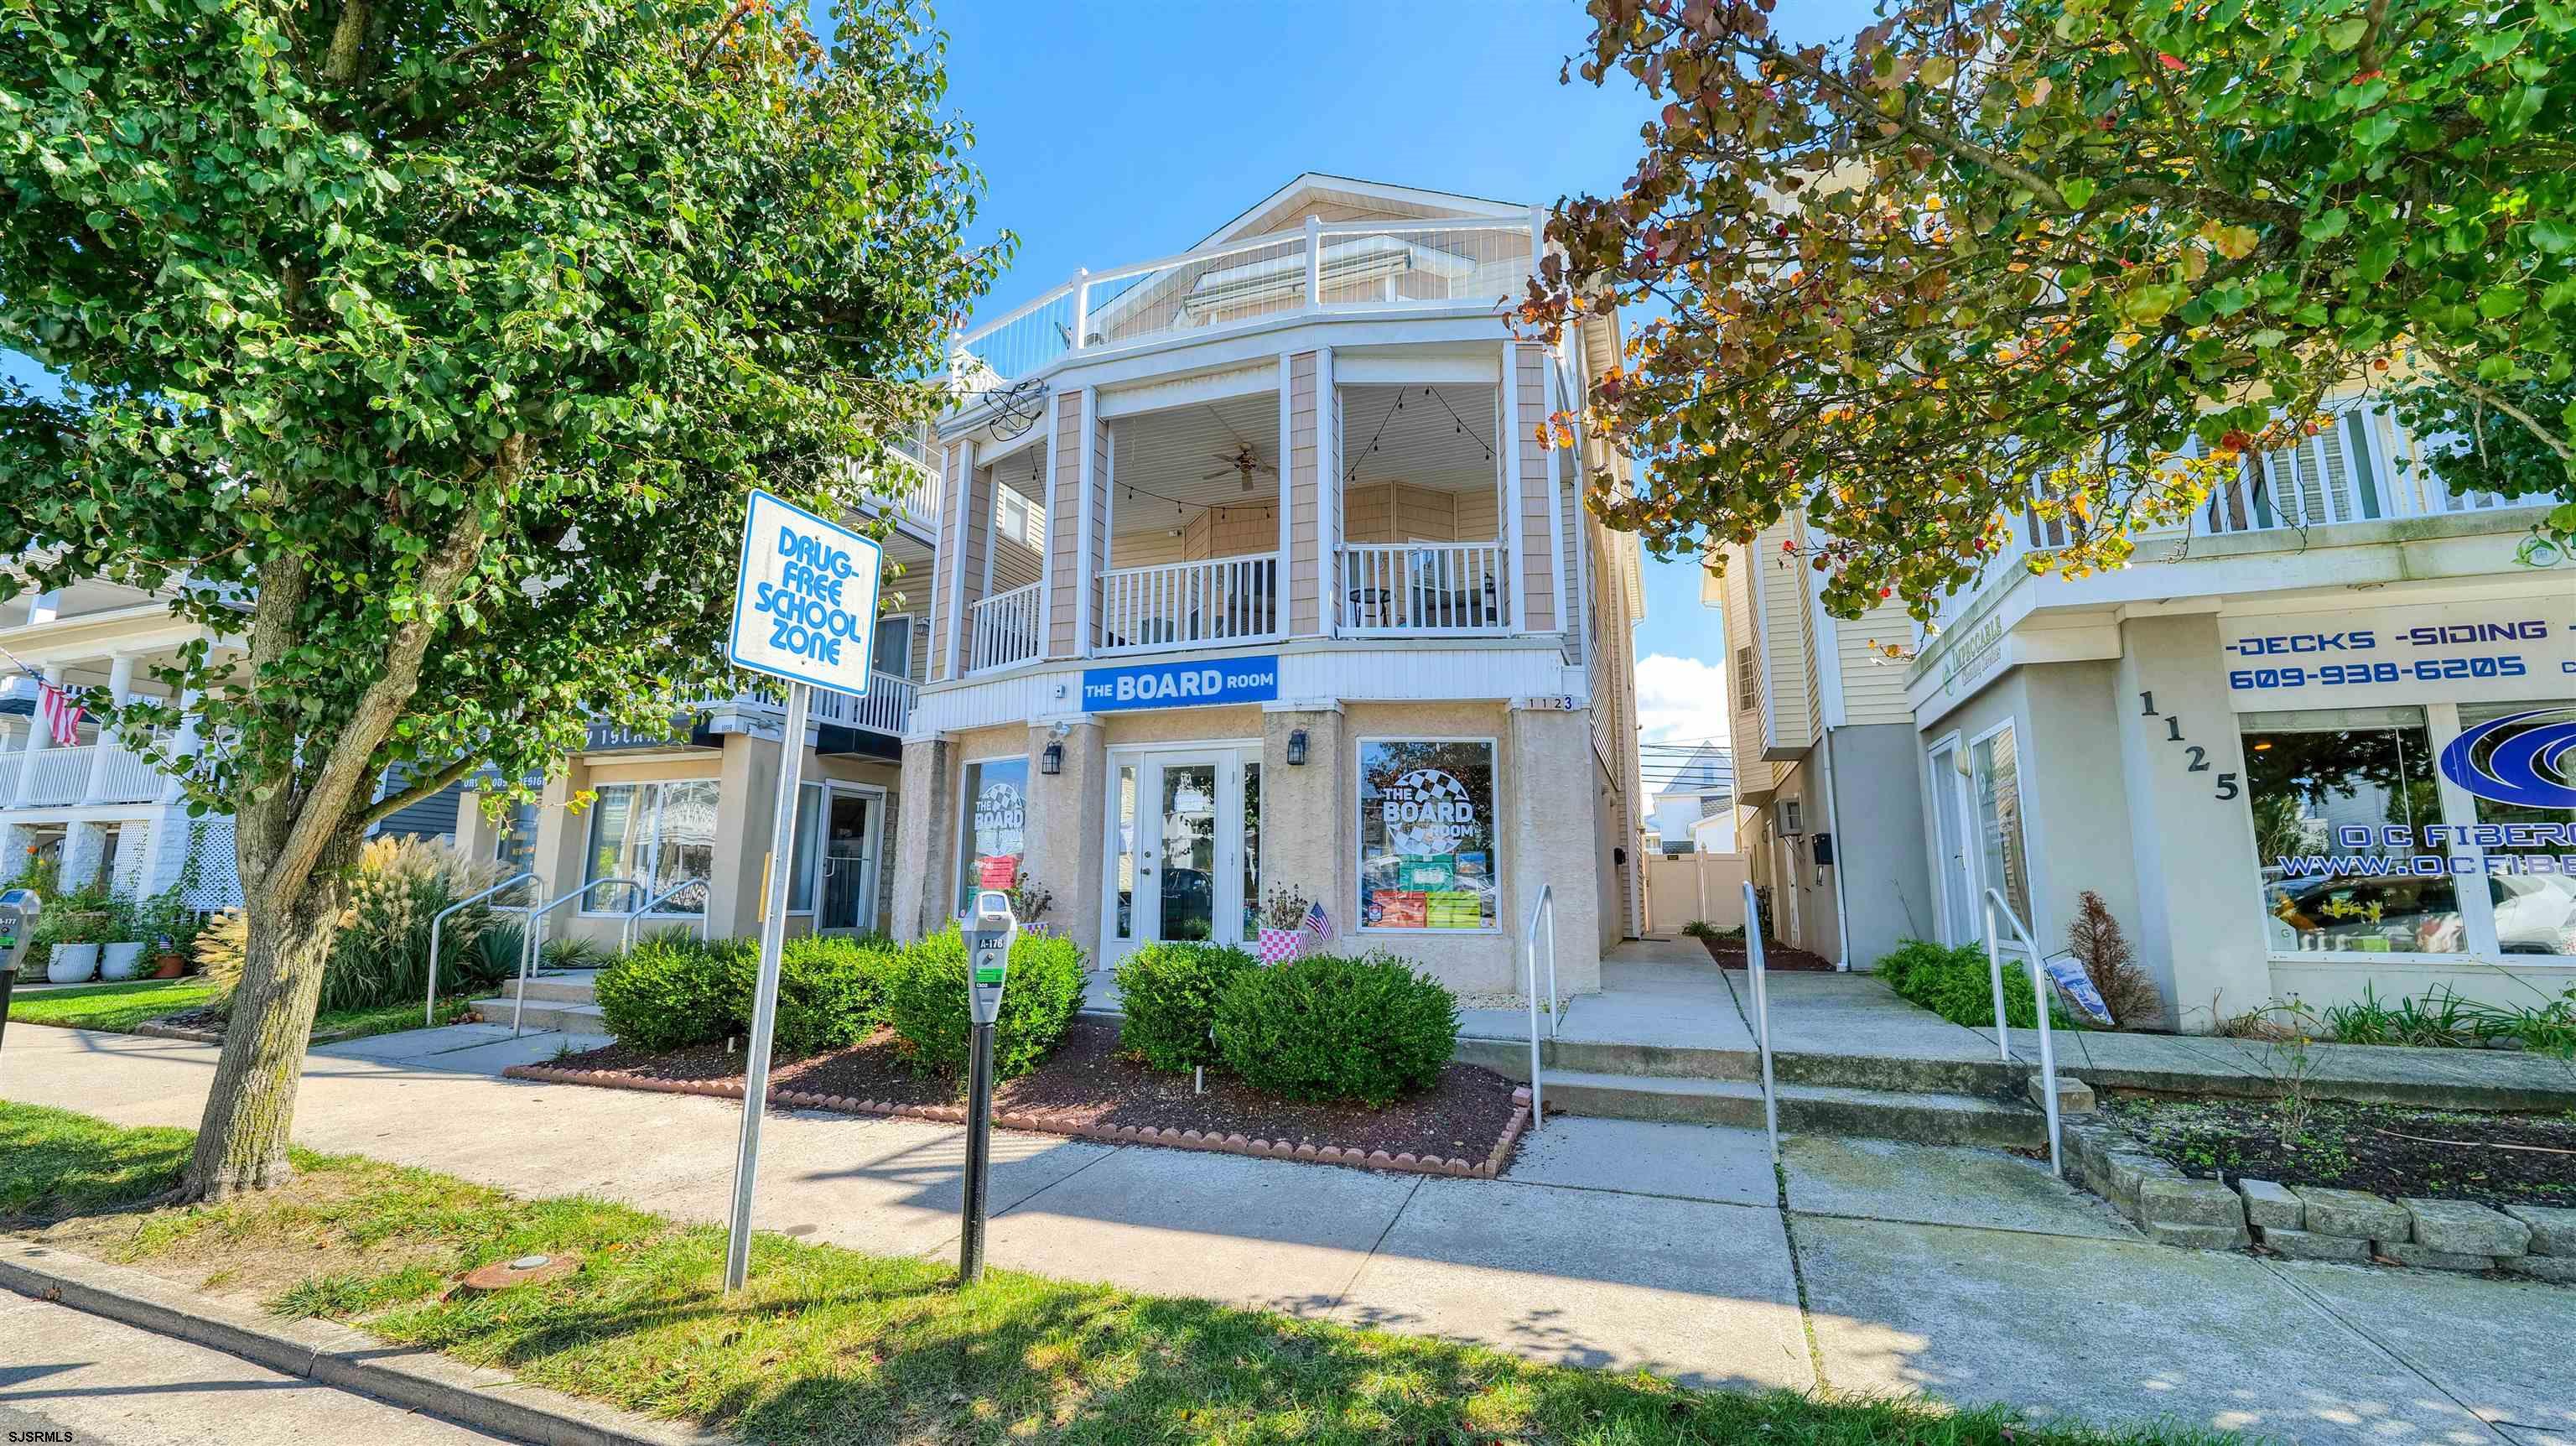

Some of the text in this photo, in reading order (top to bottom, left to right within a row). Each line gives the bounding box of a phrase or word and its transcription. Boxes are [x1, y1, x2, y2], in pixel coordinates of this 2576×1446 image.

[778, 526, 859, 580] DRUG-
[782, 560, 843, 607] FREE
[755, 582, 861, 643] SCHOOL
[769, 618, 841, 666] ZONE
[2225, 621, 2547, 656] -DECKS -SIDING
[1085, 669, 1273, 700] THE BOARD ROOM
[2230, 656, 2527, 689] 609-938-6205
[1529, 696, 1572, 710] 1123
[975, 801, 991, 812] THE
[1383, 788, 1413, 800] THE
[974, 810, 1024, 830] BOARD
[1383, 802, 1473, 822] BOARD
